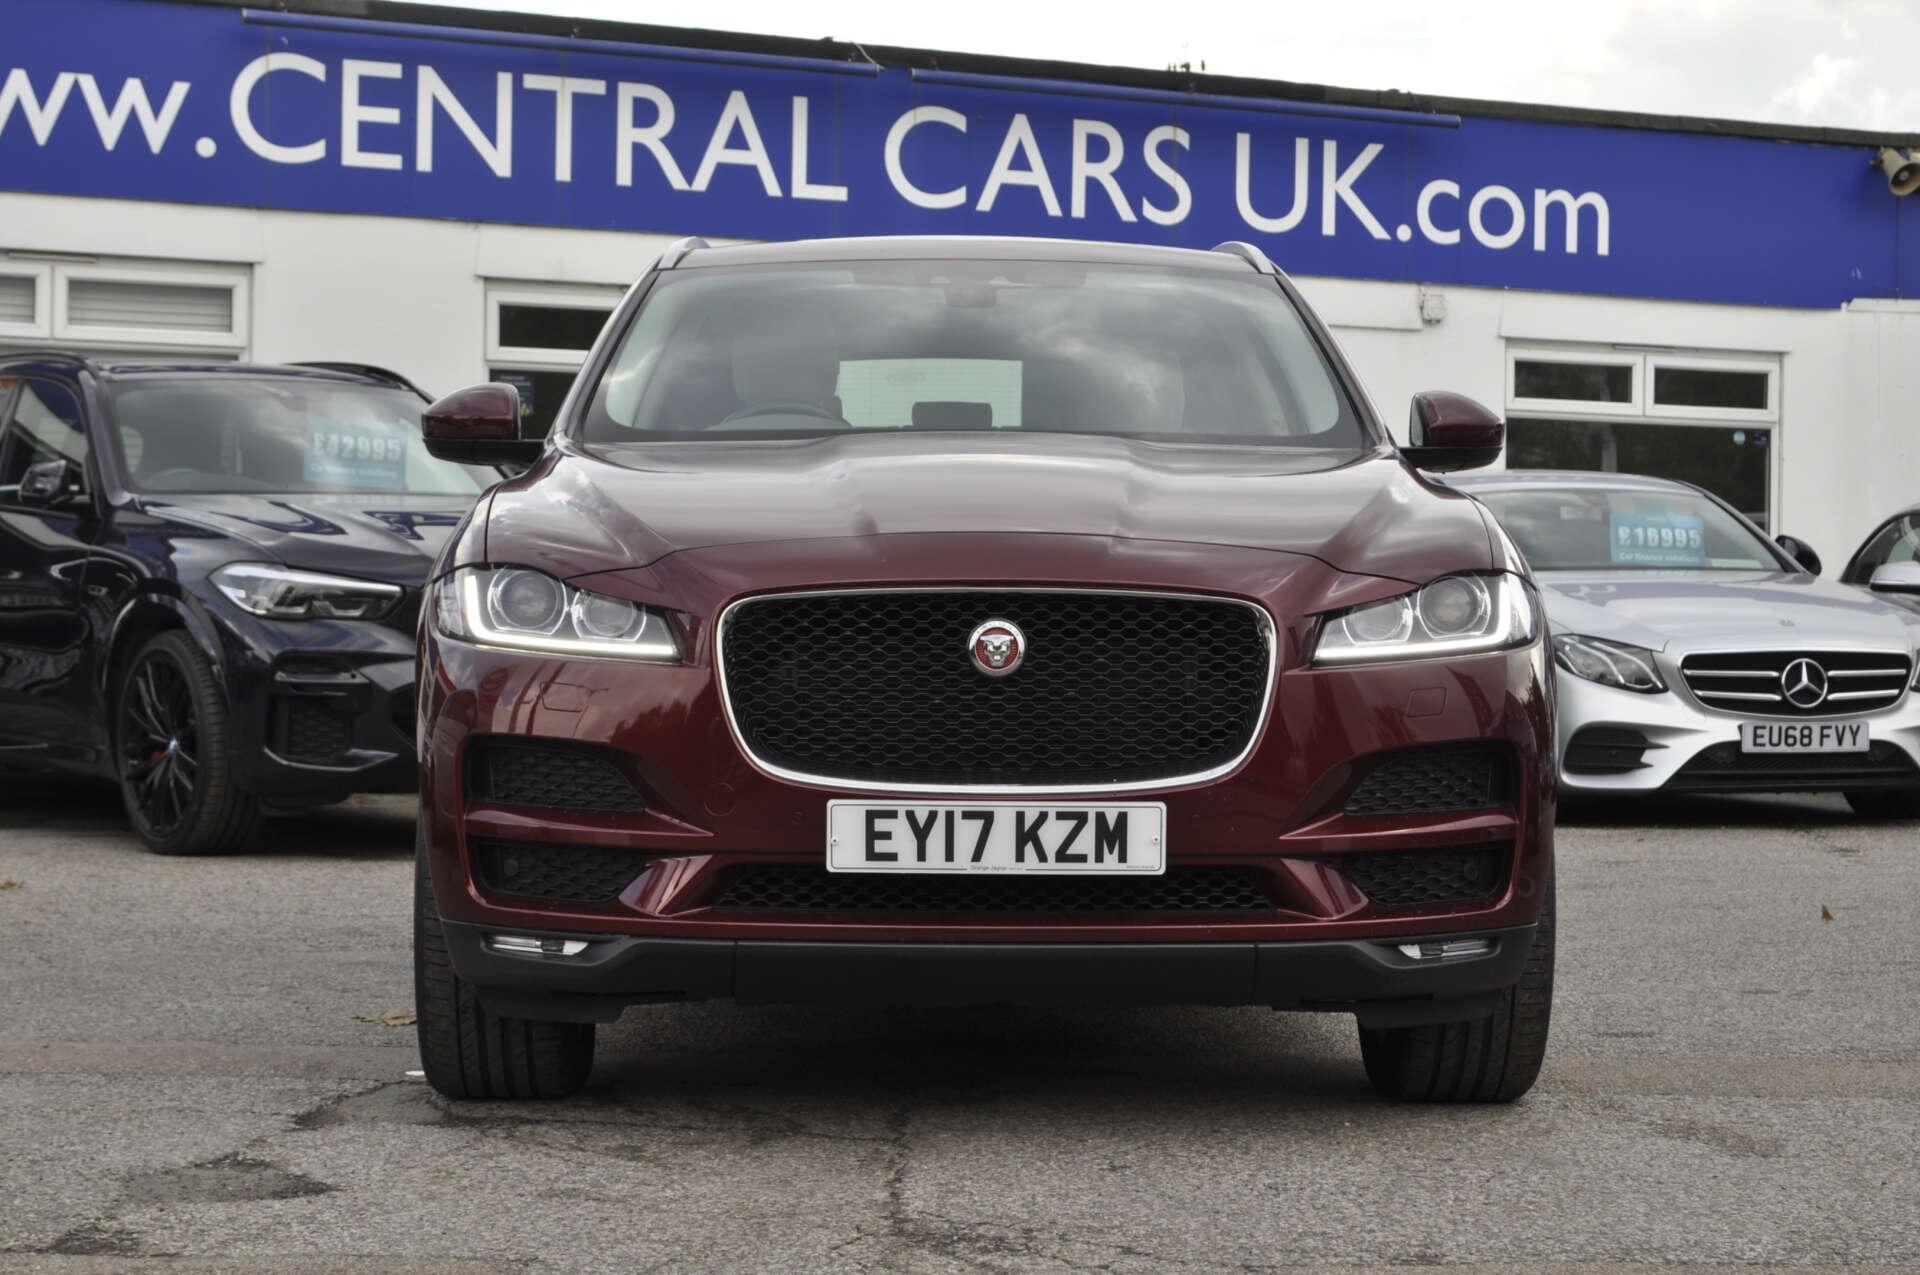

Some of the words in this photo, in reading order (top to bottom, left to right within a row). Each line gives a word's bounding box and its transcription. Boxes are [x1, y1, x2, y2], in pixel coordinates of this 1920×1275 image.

[884, 106, 1192, 226] CARS
[1235, 132, 1610, 257] UK.com
[1752, 725, 1813, 747] EU68
[1819, 725, 1861, 747] FVY
[865, 809, 995, 863] EY17
[1015, 811, 1128, 864] KZM
